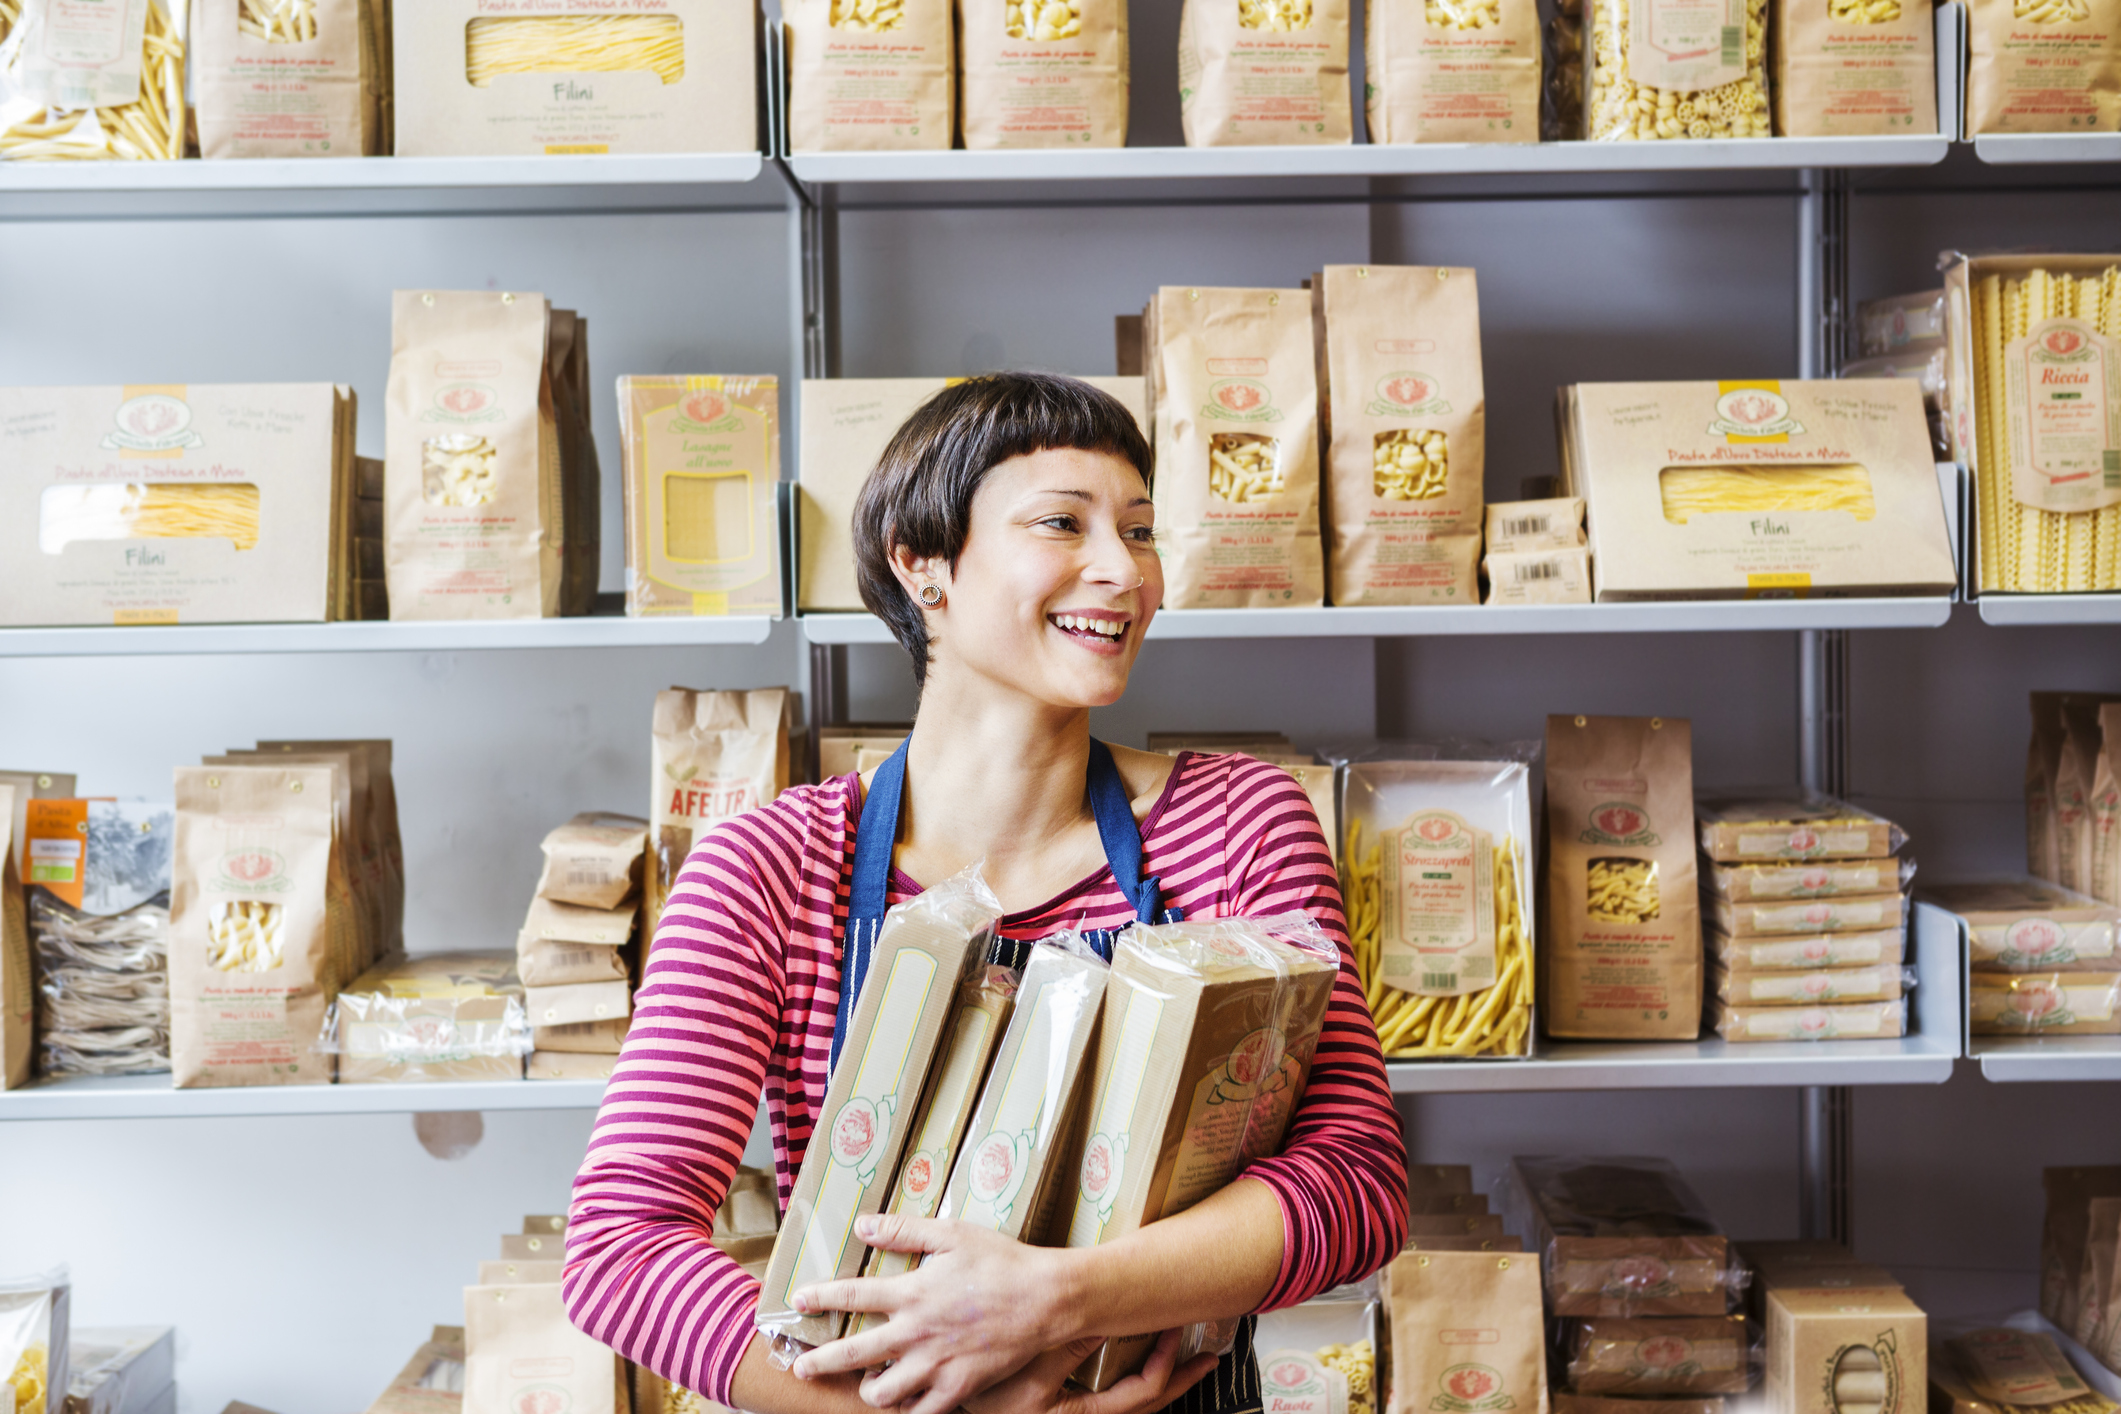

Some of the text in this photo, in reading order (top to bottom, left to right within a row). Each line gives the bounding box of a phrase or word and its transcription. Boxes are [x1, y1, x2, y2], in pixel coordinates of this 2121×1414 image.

[553, 80, 594, 101] Filini
[2041, 366, 2089, 384] Riccia
[682, 440, 732, 455] Lasagne
[1668, 448, 1707, 461] Pasta
[1817, 446, 1851, 459] Mano
[55, 465, 94, 480] Pasta
[211, 463, 245, 478] Mano
[1751, 517, 1790, 536] Filini
[125, 546, 165, 567] Filini
[670, 786, 760, 818] AFELTRA
[1402, 853, 1473, 870] Strozzapreti
[1271, 1398, 1314, 1412] Ruote
